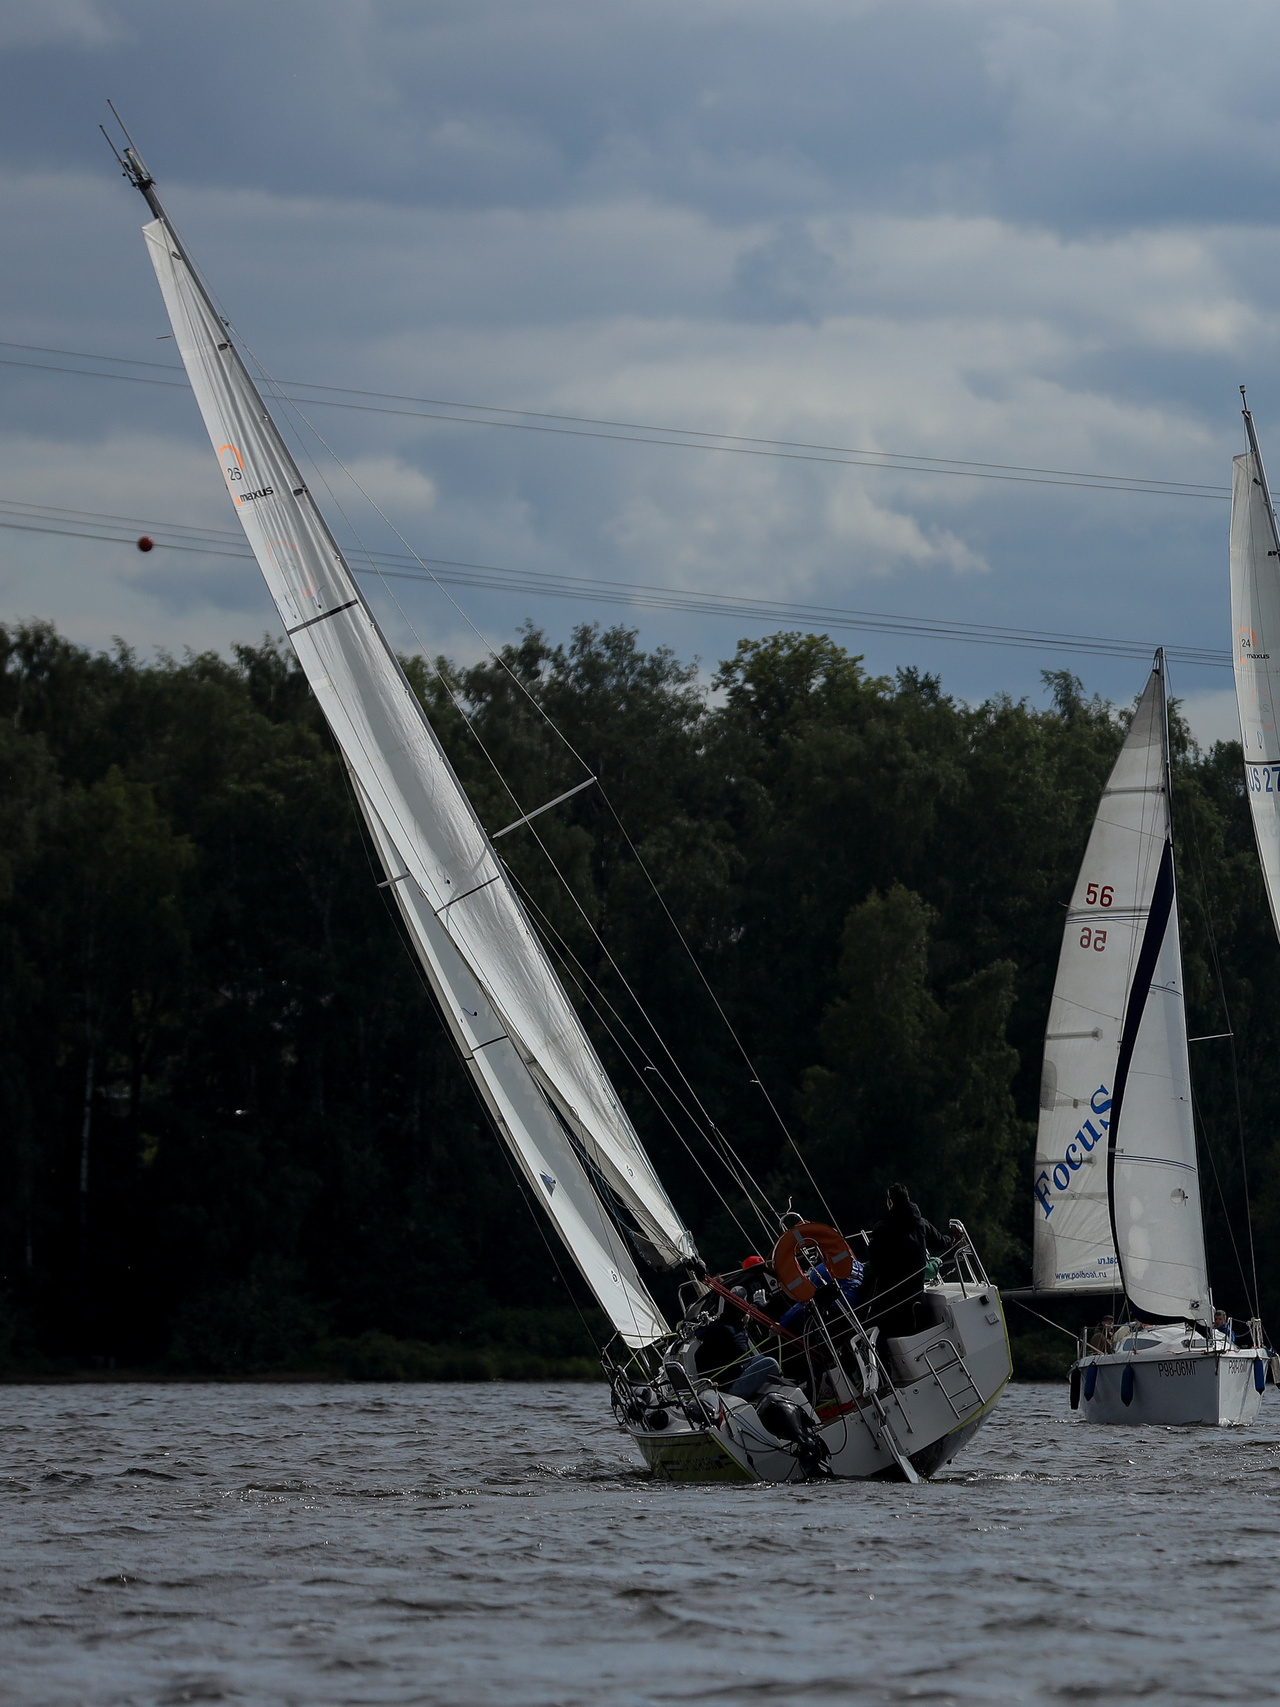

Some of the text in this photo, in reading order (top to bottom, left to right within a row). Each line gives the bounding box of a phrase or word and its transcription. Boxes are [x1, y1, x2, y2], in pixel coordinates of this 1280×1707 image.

[227, 467, 242, 481] 26
[239, 486, 274, 502] maxus
[1241, 638, 1251, 648] 24
[1247, 767, 1261, 792] US
[1086, 883, 1114, 907] 56
